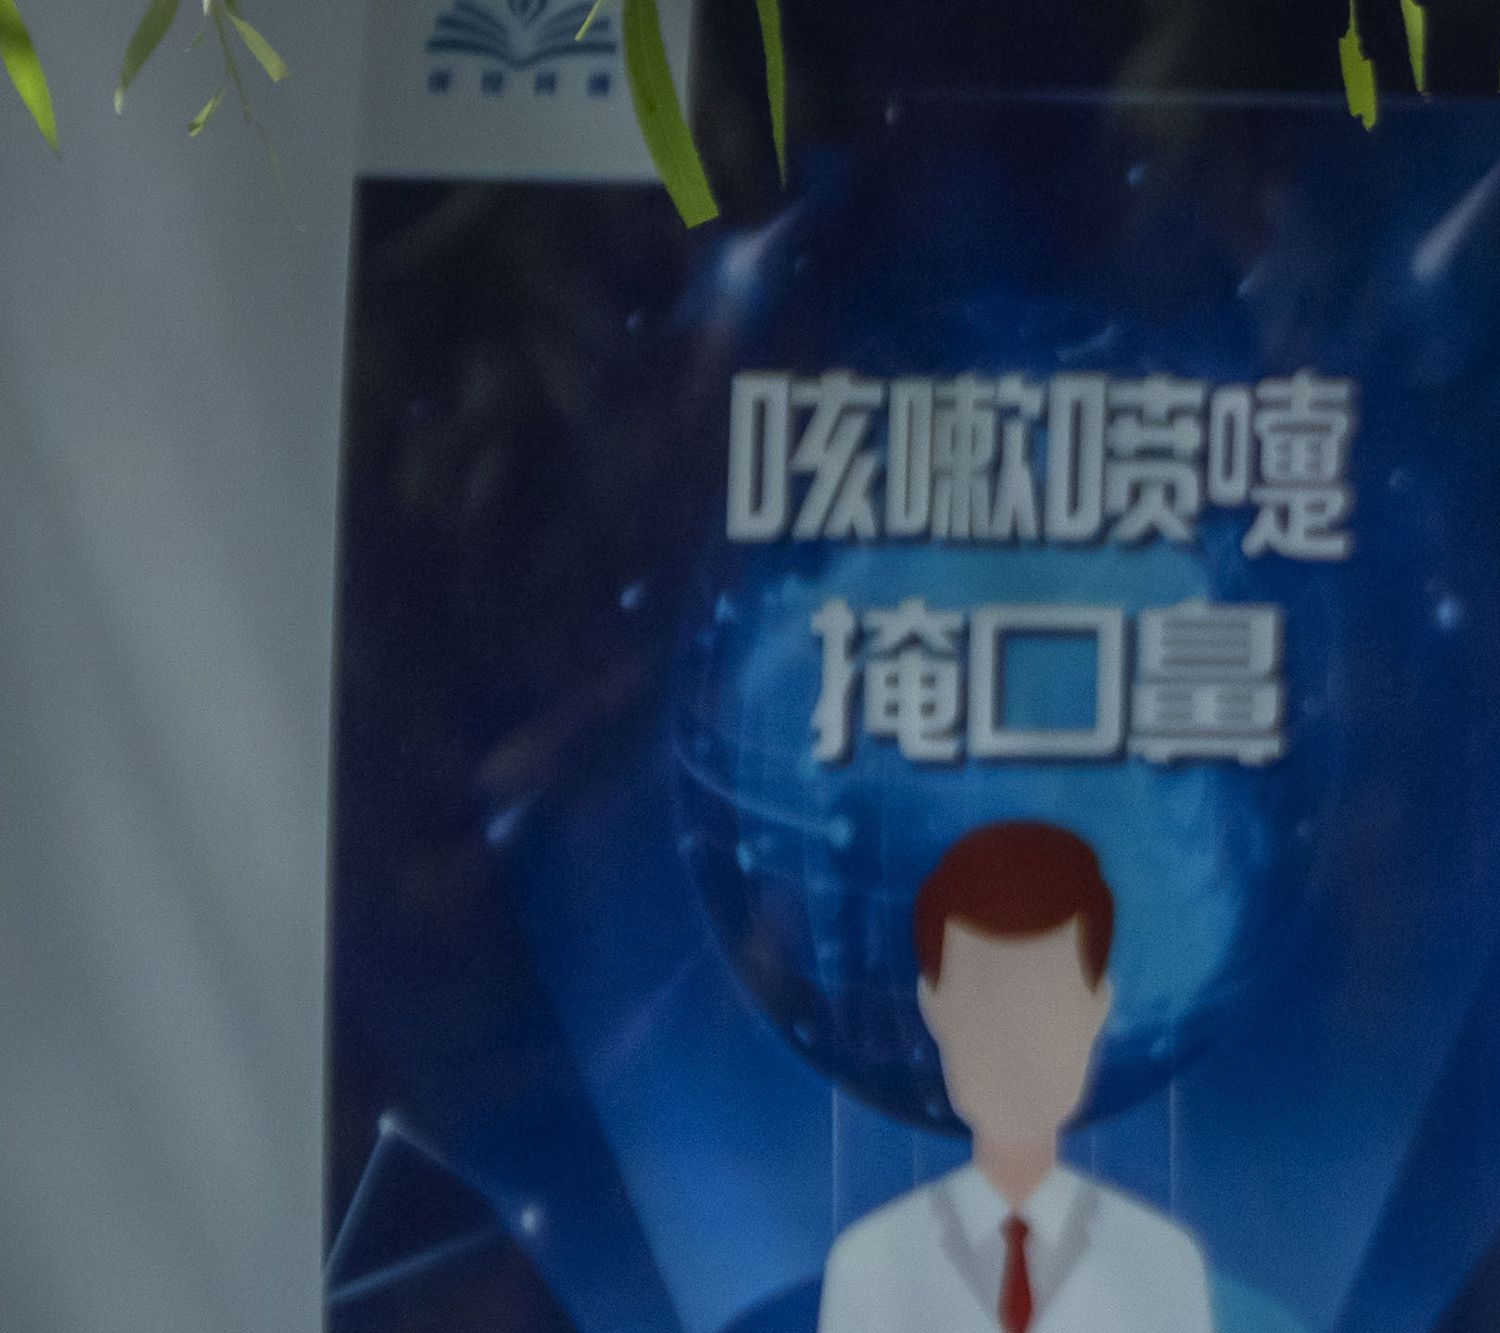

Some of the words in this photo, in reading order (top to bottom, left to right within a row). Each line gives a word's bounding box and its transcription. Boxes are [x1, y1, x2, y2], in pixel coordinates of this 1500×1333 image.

[725, 370, 1356, 560] 咳嗽喷嚏
[811, 598, 1285, 766] 掩口鼻
